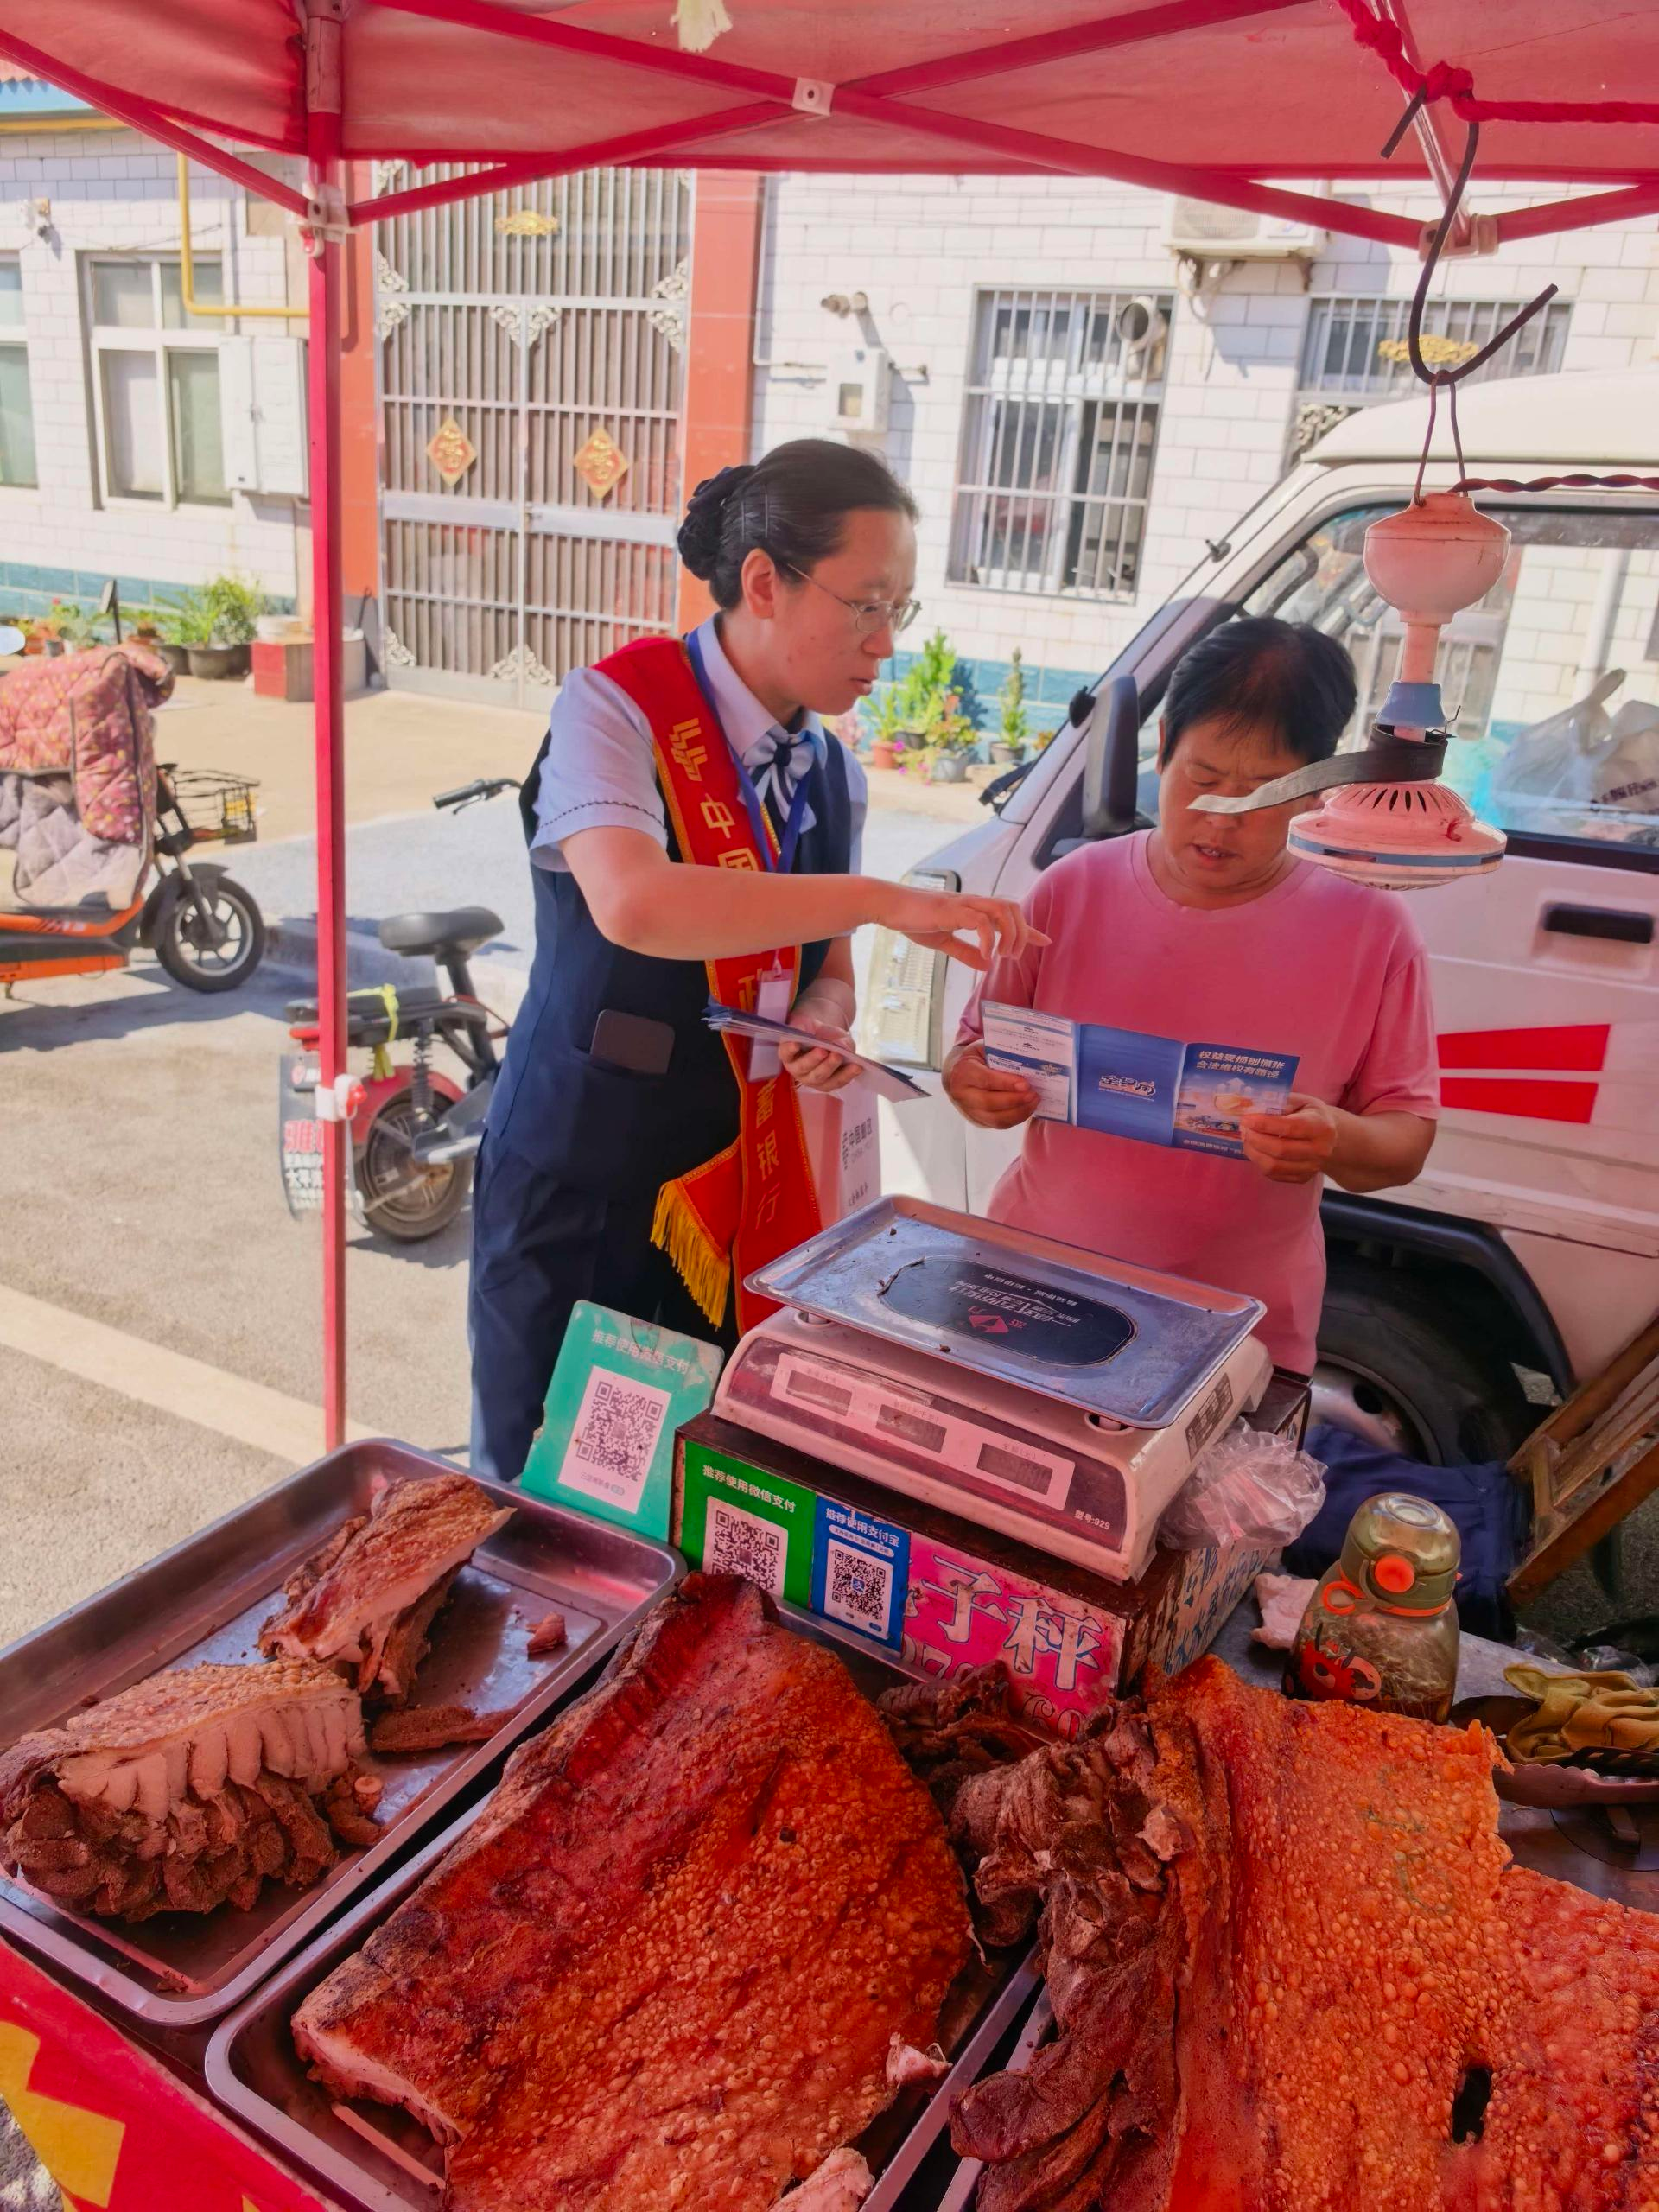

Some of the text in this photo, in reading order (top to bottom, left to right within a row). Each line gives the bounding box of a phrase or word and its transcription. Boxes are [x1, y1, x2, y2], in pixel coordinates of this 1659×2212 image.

[702, 1464, 796, 1514] 推荐使用微信支付
[825, 1507, 900, 1548] 推荐使用支付宝
[1074, 1510, 1111, 1530] 型号:929
[899, 1554, 1103, 1691] 子秤
